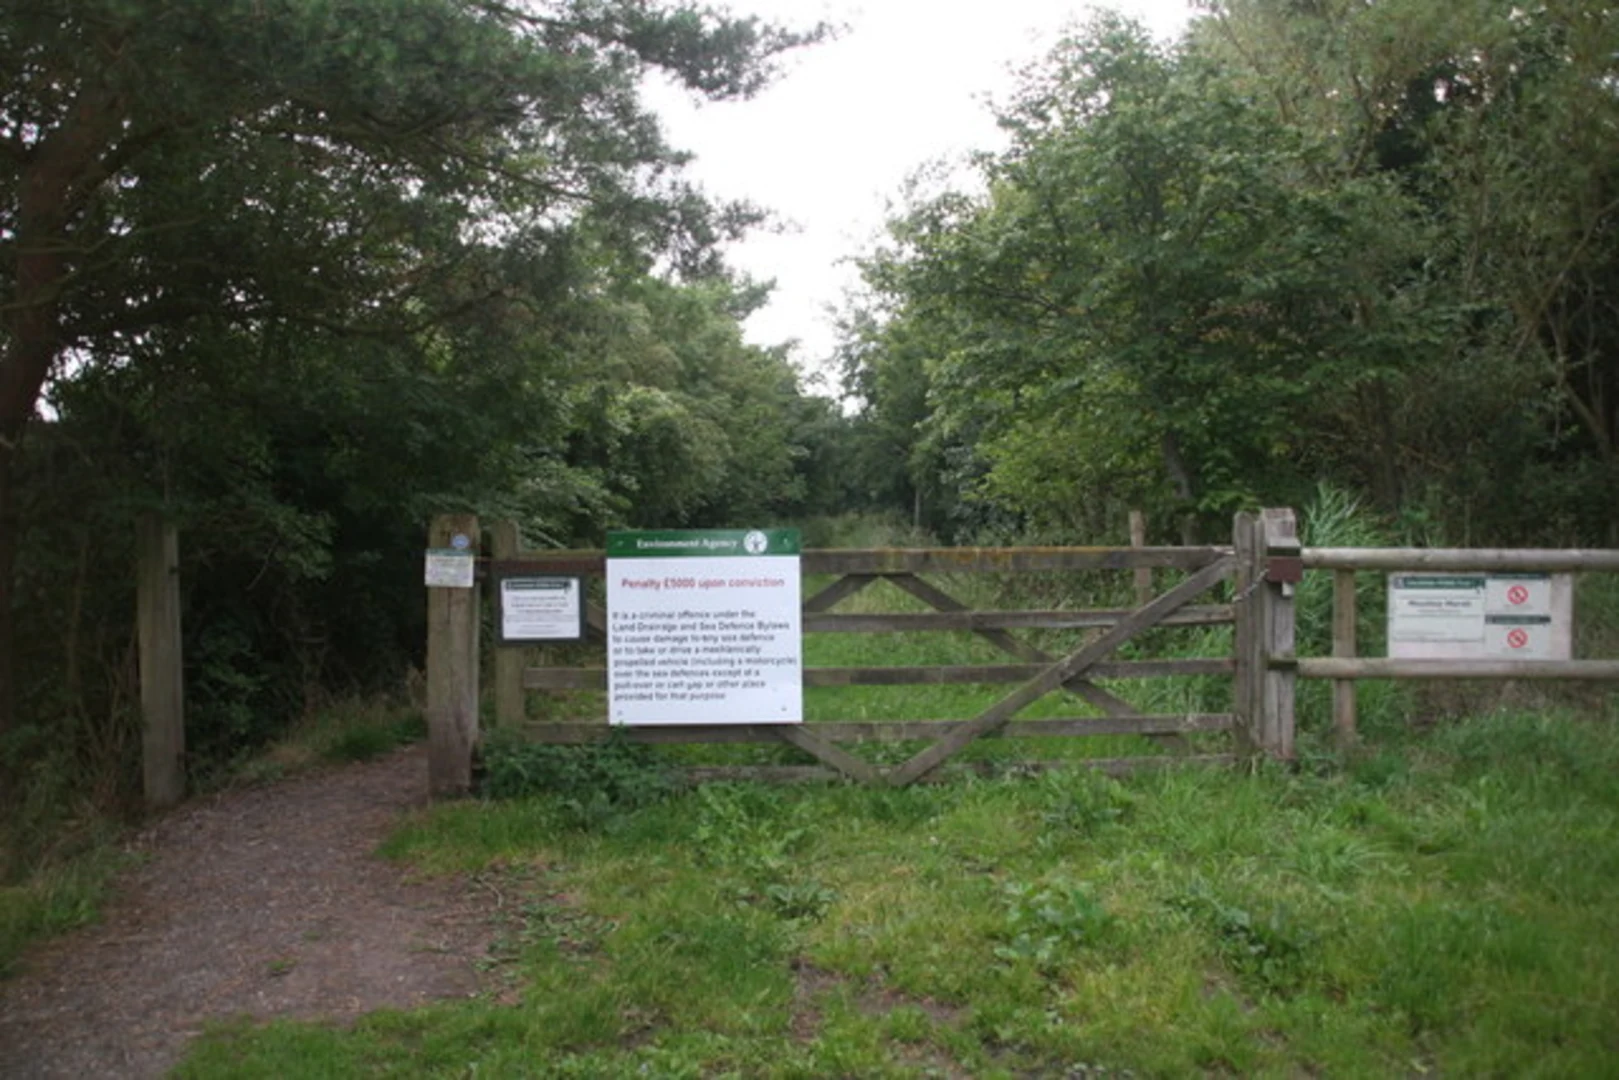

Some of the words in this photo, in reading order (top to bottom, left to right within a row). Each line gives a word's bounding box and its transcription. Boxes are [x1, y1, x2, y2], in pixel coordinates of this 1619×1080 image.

[636, 539, 699, 548] Environment
[702, 538, 737, 549] Agency
[621, 578, 660, 589] Penalty
[664, 578, 695, 588] £5000
[699, 579, 726, 590] upon
[729, 578, 785, 587] conviction
[640, 611, 674, 619] criminal
[677, 610, 710, 618] offence
[713, 610, 739, 618] under
[741, 610, 755, 618] the
[612, 623, 635, 632] Land
[637, 622, 677, 632] Drainage
[680, 622, 696, 631] and
[699, 622, 716, 631] Sea
[718, 622, 754, 630] Defence
[612, 634, 621, 642] to
[653, 633, 689, 644] damage
[739, 633, 775, 642] defence
[614, 658, 655, 668] propelled
[658, 657, 689, 666] vehicle
[635, 669, 649, 677] the
[671, 668, 709, 677] defences
[716, 679, 739, 688] other
[742, 679, 766, 689] place
[614, 692, 653, 701] provided
[655, 692, 668, 700] for
[690, 692, 726, 701] purpose
